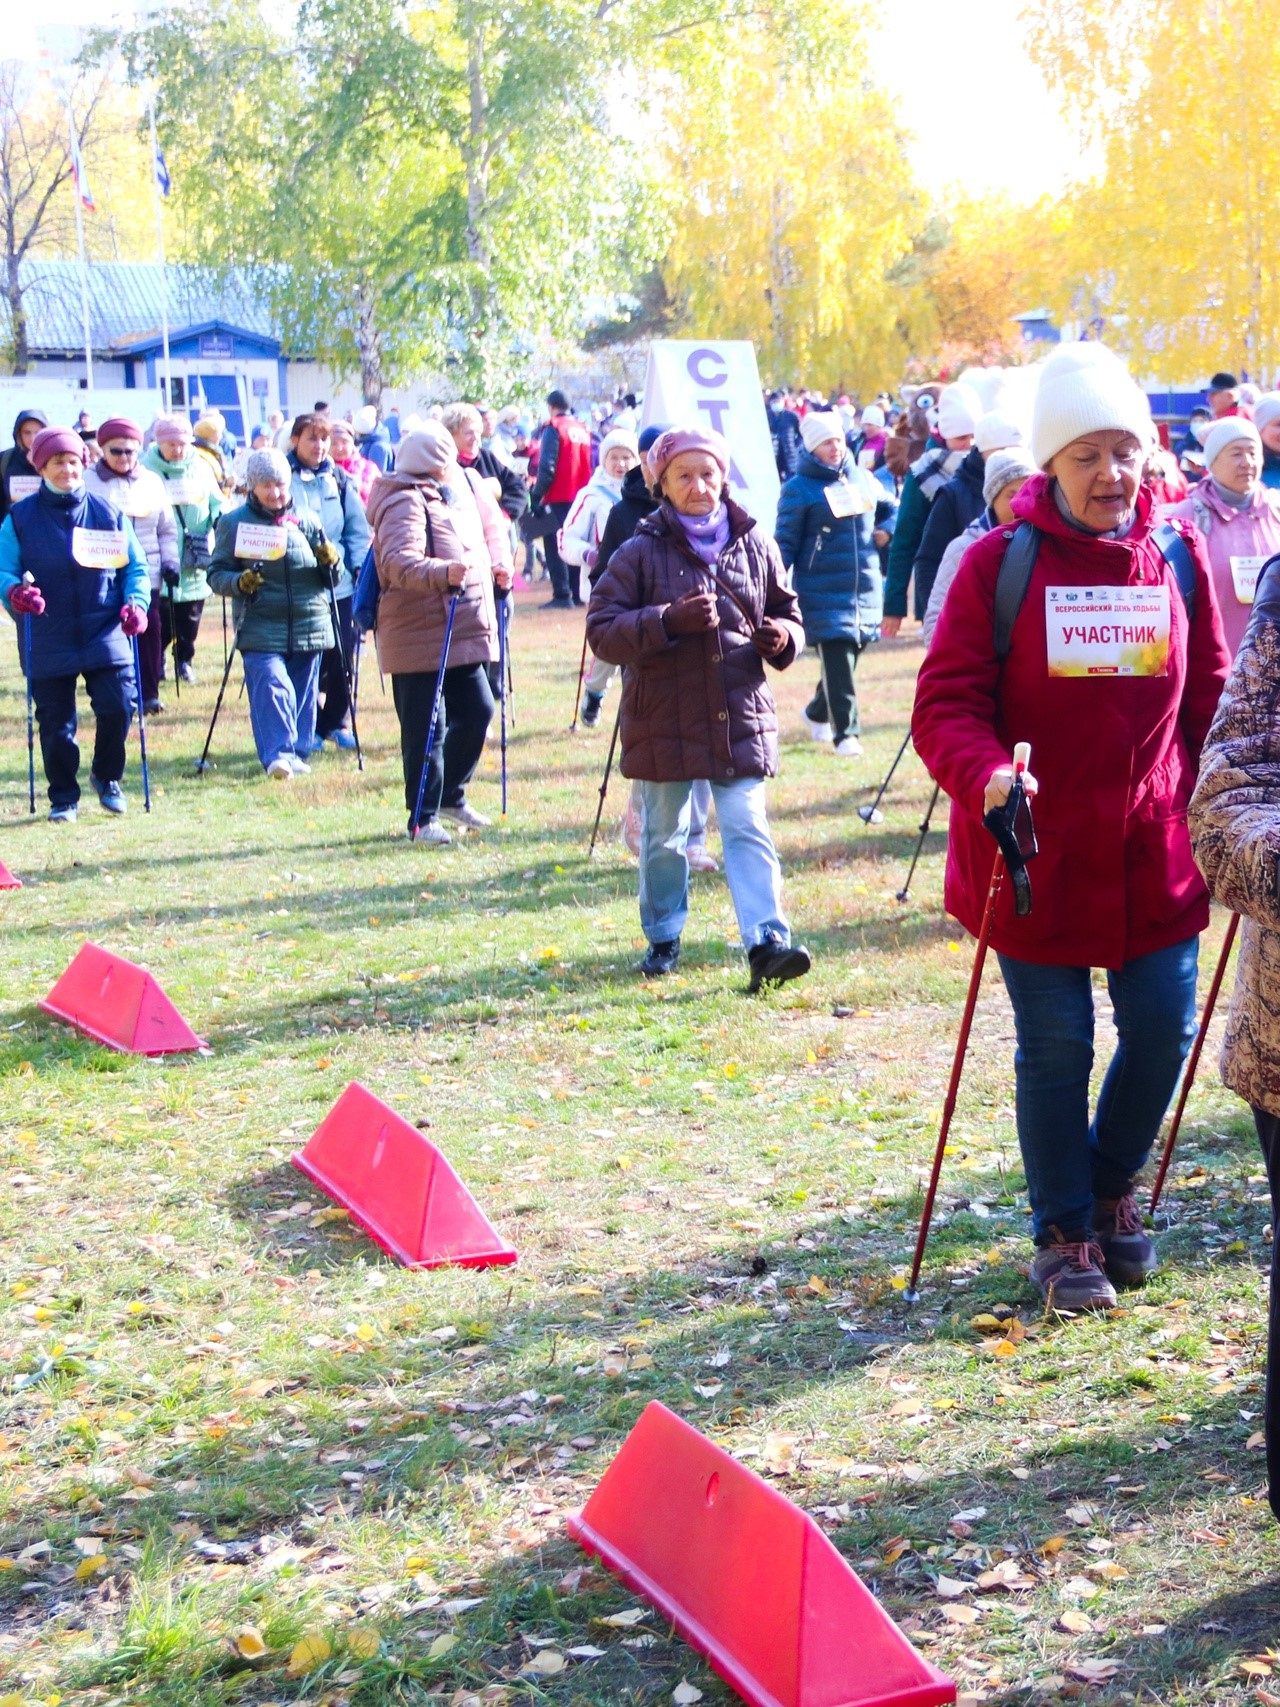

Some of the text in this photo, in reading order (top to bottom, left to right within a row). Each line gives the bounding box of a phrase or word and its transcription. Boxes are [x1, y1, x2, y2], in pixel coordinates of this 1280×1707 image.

[242, 539, 280, 549] УЧАСТНИК
[1055, 604, 1161, 613] ВСЕРОССИЙСКИЙ ДЕНЬ ХОДЬБЫ
[1062, 626, 1156, 644] УЧАСТНИК
